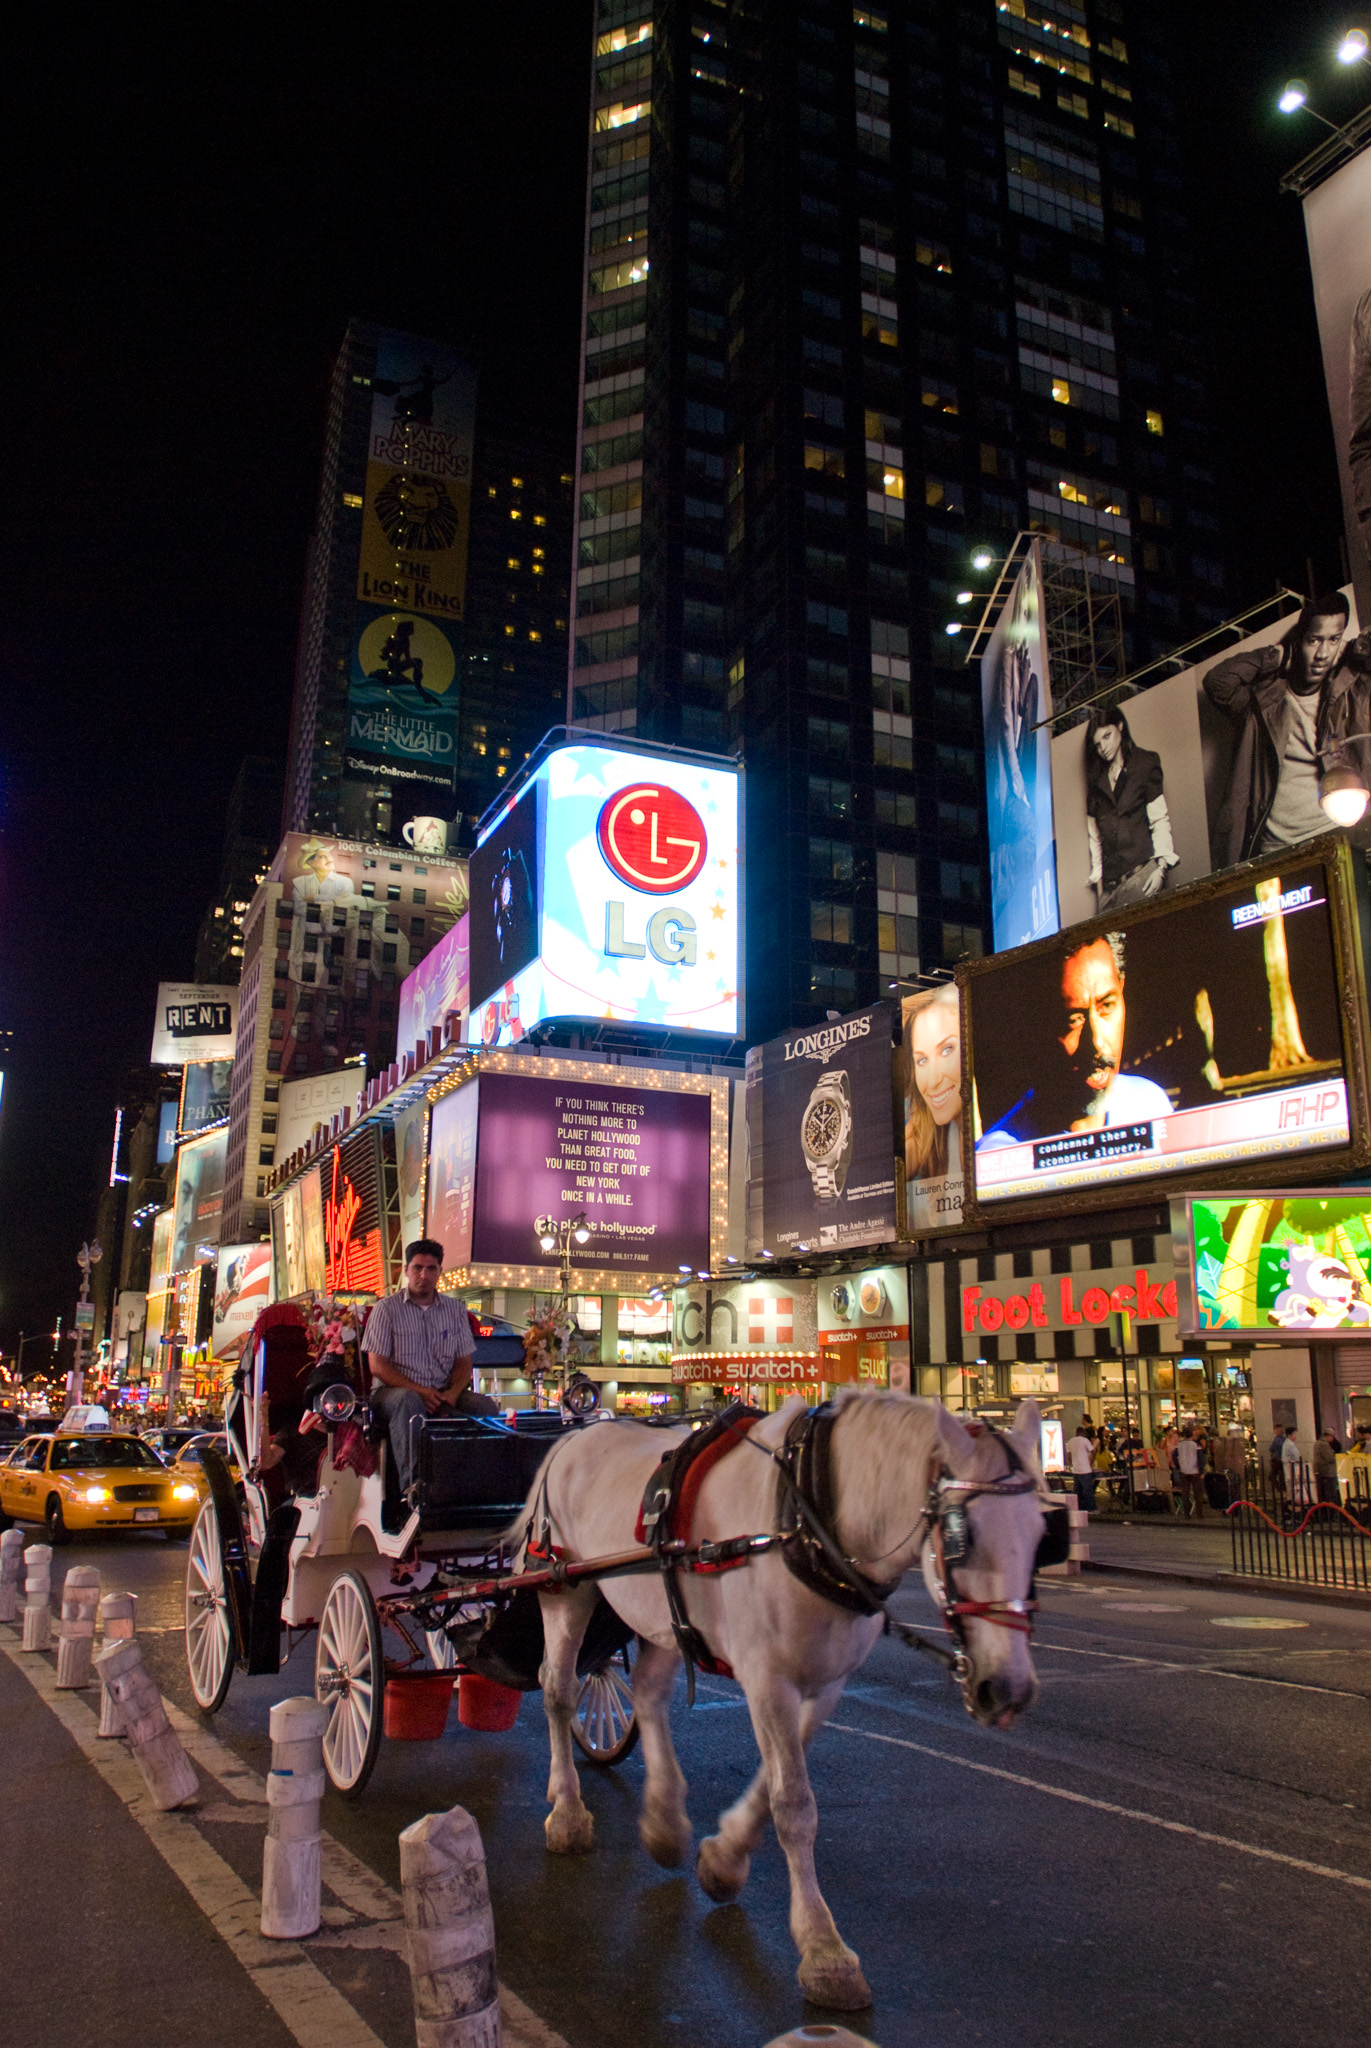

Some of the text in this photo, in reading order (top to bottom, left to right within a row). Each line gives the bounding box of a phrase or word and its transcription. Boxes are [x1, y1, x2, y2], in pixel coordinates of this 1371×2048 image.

[390, 420, 457, 454] MARY
[373, 435, 468, 477] POPPINS
[398, 560, 431, 579] THE
[374, 711, 398, 726] THE
[400, 716, 436, 733] LITTLE
[350, 715, 453, 754] MERMAID
[338, 842, 457, 868] 100% Colombian Coffee
[1032, 869, 1051, 931] GAP
[1232, 886, 1312, 924] REENACTMENT
[604, 900, 698, 967] LG
[168, 1006, 226, 1027] RENT
[784, 1015, 871, 1061] LONGINES
[356, 1010, 461, 1119] BUILDING
[186, 1104, 230, 1120] PHAN
[555, 1096, 645, 1116] IF YOU THINK THERE'S
[562, 1113, 637, 1130] NOTHING MORE TO
[558, 1128, 641, 1145] PLANET HOLLYWOOD
[1038, 1135, 1094, 1155] condemned
[1101, 1131, 1128, 1143] them
[1134, 1126, 1147, 1137] to
[560, 1143, 637, 1162] THAN GREAT FOOD,
[1008, 1181, 1048, 1194] SPEECH.
[1055, 1173, 1097, 1186] FOURTH
[1100, 1168, 1111, 1179] IN
[1112, 1167, 1120, 1177] A
[1122, 1162, 1162, 1176] SERIES
[1164, 1158, 1179, 1168] OF
[1182, 1140, 1283, 1165] REENACTMENTS
[1286, 1136, 1303, 1148] OF
[1308, 1128, 1350, 1144] VIETN
[1040, 1150, 1088, 1168] economic
[1095, 1142, 1148, 1157] slavery.
[545, 1157, 651, 1177] YOU NEED TO GET OUT OF
[576, 1176, 620, 1189] NEW YORK
[915, 1181, 965, 1196] Lauren Conr
[561, 1190, 633, 1206] ONCE IN A WHILE.
[561, 1218, 598, 1232] plat
[600, 1220, 655, 1236] hollywood
[839, 1217, 885, 1232] The Andre Agassi
[777, 1231, 799, 1243] Longines
[861, 1230, 886, 1240] Foundation
[230, 1311, 254, 1322] maxell
[963, 1283, 1048, 1332] Foot
[673, 1360, 804, 1380] swatch swatch
